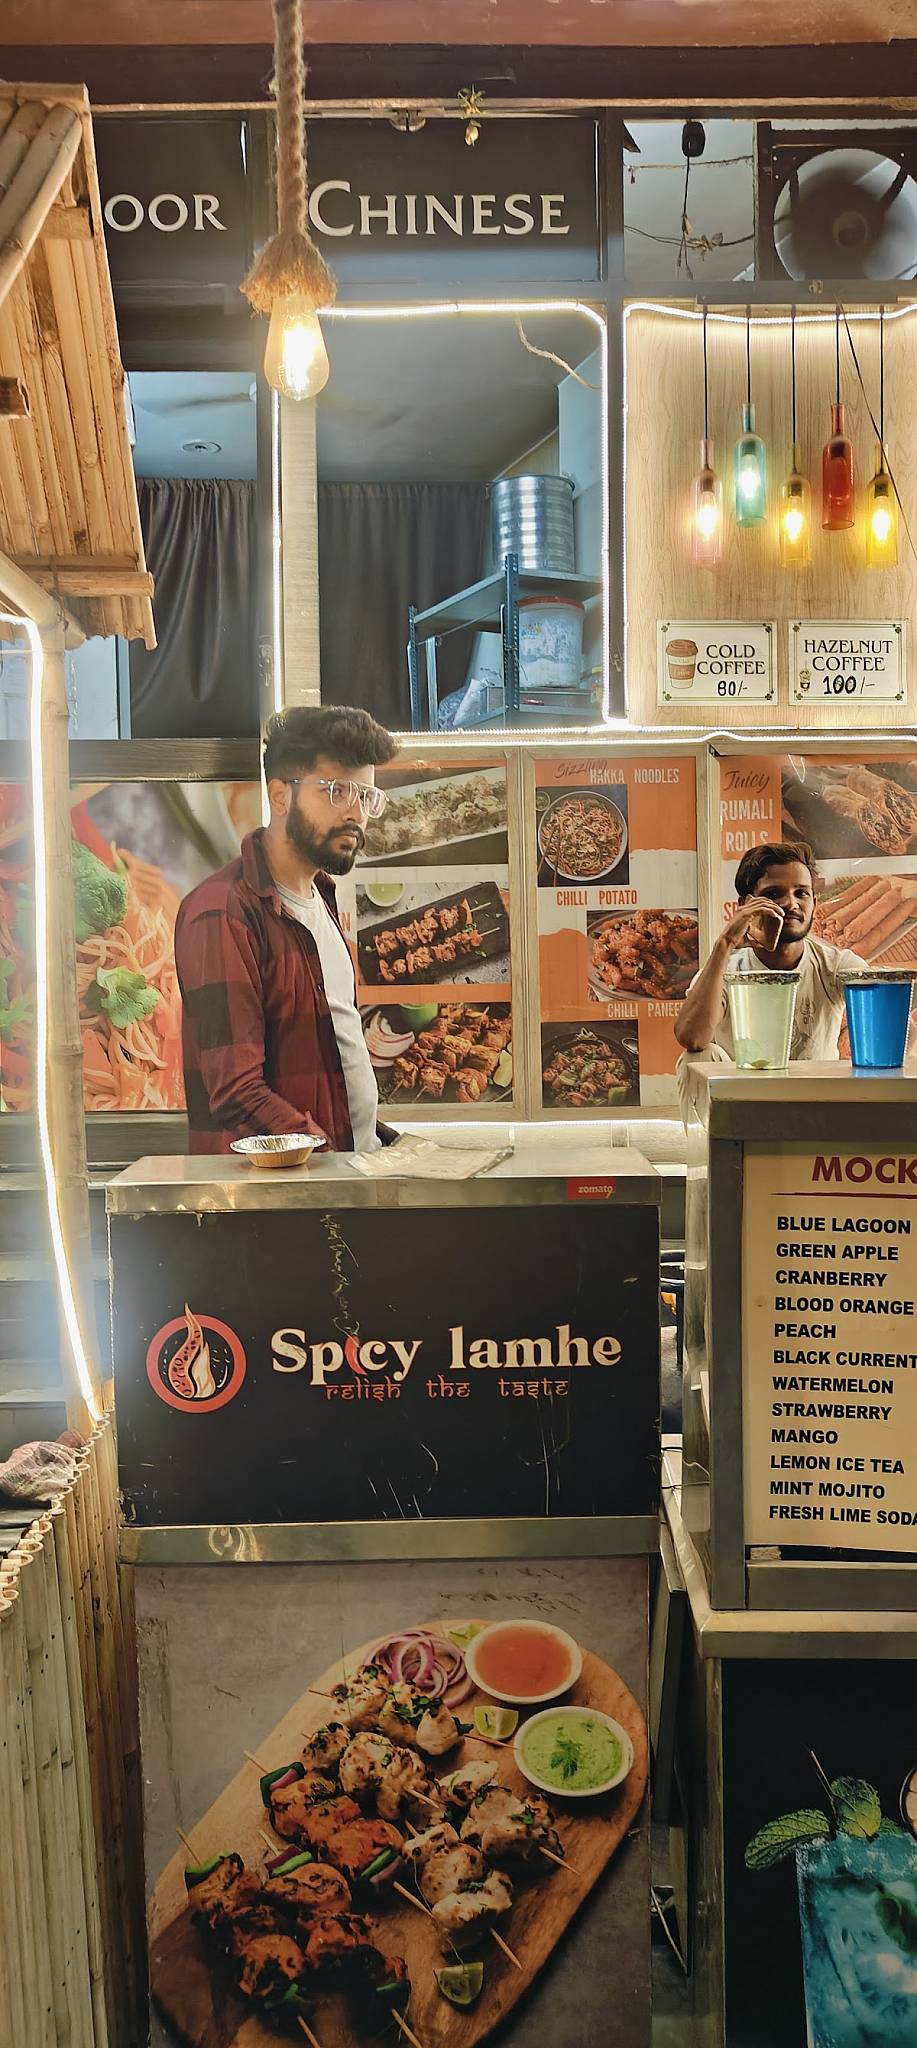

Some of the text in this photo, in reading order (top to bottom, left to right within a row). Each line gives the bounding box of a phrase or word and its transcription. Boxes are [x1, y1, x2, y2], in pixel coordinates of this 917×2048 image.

[308, 180, 570, 236] CHINESE
[706, 644, 755, 658] COLD
[804, 639, 893, 653] HAZELNUT
[696, 661, 766, 675] COFFEE
[812, 656, 886, 671] COFFEE
[589, 767, 680, 784] HAKKA NOODLES
[724, 770, 770, 794] Juicy
[720, 798, 773, 822] RUMALI
[556, 890, 637, 906] CHILLI POTATO
[607, 1003, 639, 1017] CHILLI
[812, 1156, 917, 1184] MOCK
[578, 1185, 614, 1198] zomato
[777, 1216, 911, 1234] BLUE LAGOON
[776, 1243, 899, 1260] GREEN APPLE
[775, 1270, 887, 1287] CRANBERRY
[775, 1297, 914, 1315] BLOOD ORANGE
[774, 1324, 837, 1338] PEACH
[271, 1323, 622, 1385] Spicy lamhe
[773, 1350, 917, 1368] BLACK CURRENT
[325, 1375, 569, 1402] relish the taste
[772, 1377, 894, 1394] WATERMELON
[772, 1403, 892, 1420] STRAWBERRY
[771, 1429, 838, 1444] MANGO
[770, 1455, 905, 1474] LEMON ICE TEA
[770, 1481, 885, 1499] MINT MOJITO
[769, 1506, 824, 1521] FRESH
[830, 1508, 871, 1523] LIME
